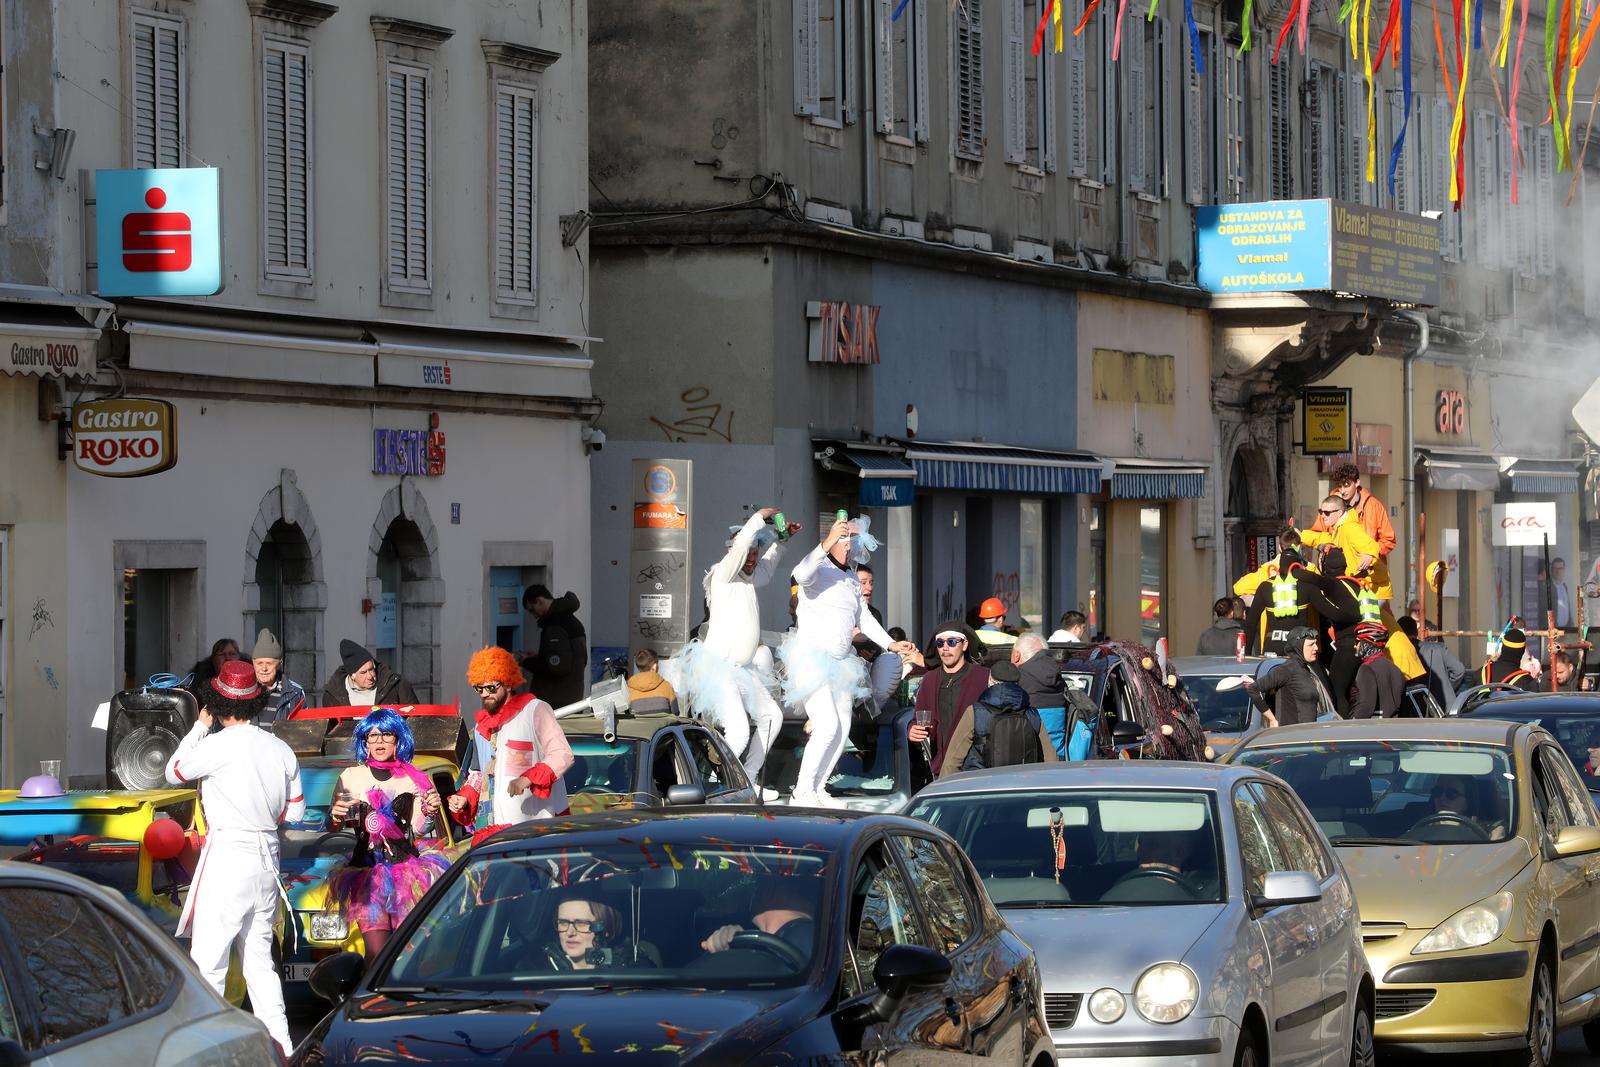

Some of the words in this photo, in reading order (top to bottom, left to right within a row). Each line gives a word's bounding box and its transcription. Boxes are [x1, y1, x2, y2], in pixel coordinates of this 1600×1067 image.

[1220, 211, 1284, 223] USTANOVA
[1288, 209, 1303, 219] ZA
[1217, 221, 1306, 235] OBRAZOVANJE
[1231, 234, 1292, 246] ODRASLIH
[1237, 252, 1288, 264] Vlamal
[1221, 271, 1304, 286] AUTOŠKOLA
[812, 302, 881, 364] TISAK
[11, 342, 45, 366] Gastro
[46, 343, 79, 374] ROKO
[423, 365, 444, 384] ERSTE
[77, 408, 159, 429] Gastro
[79, 437, 160, 466] ROKO
[374, 429, 429, 476] ERSTE
[881, 485, 897, 500] TISAK
[1501, 516, 1546, 529] ara
[284, 965, 295, 980] RI
